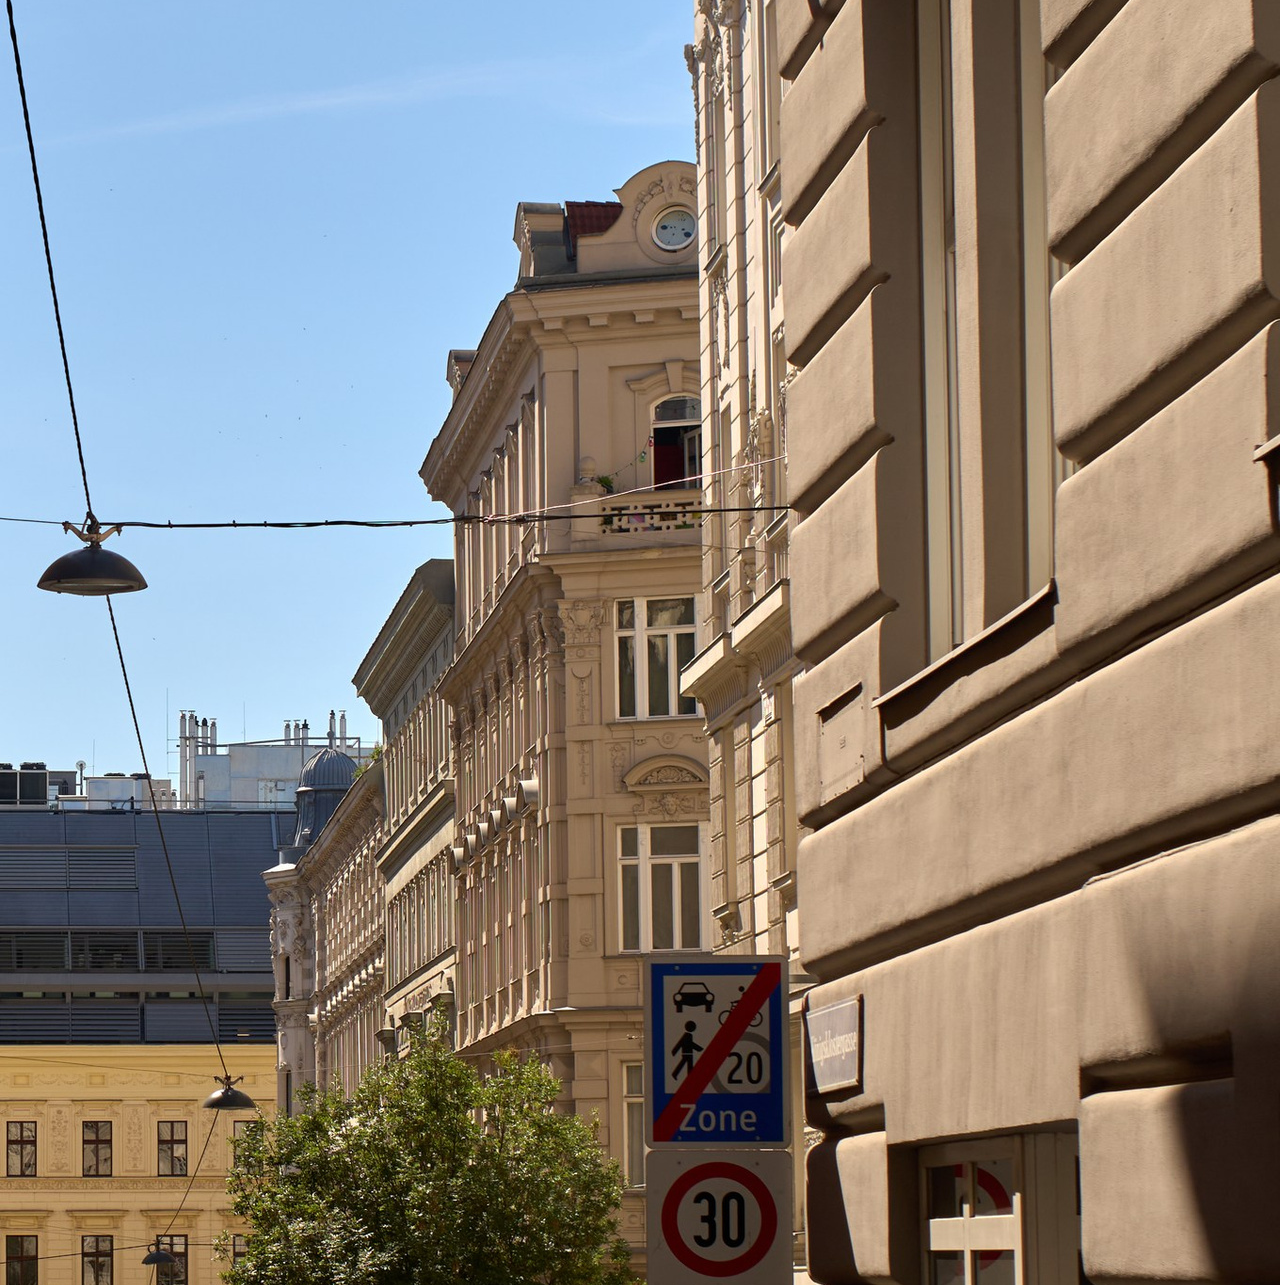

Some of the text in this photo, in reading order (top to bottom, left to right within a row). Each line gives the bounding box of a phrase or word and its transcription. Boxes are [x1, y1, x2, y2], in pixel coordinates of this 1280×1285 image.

[727, 1051, 764, 1085] 20
[679, 1103, 758, 1133] Zone
[693, 1191, 746, 1248] 30
